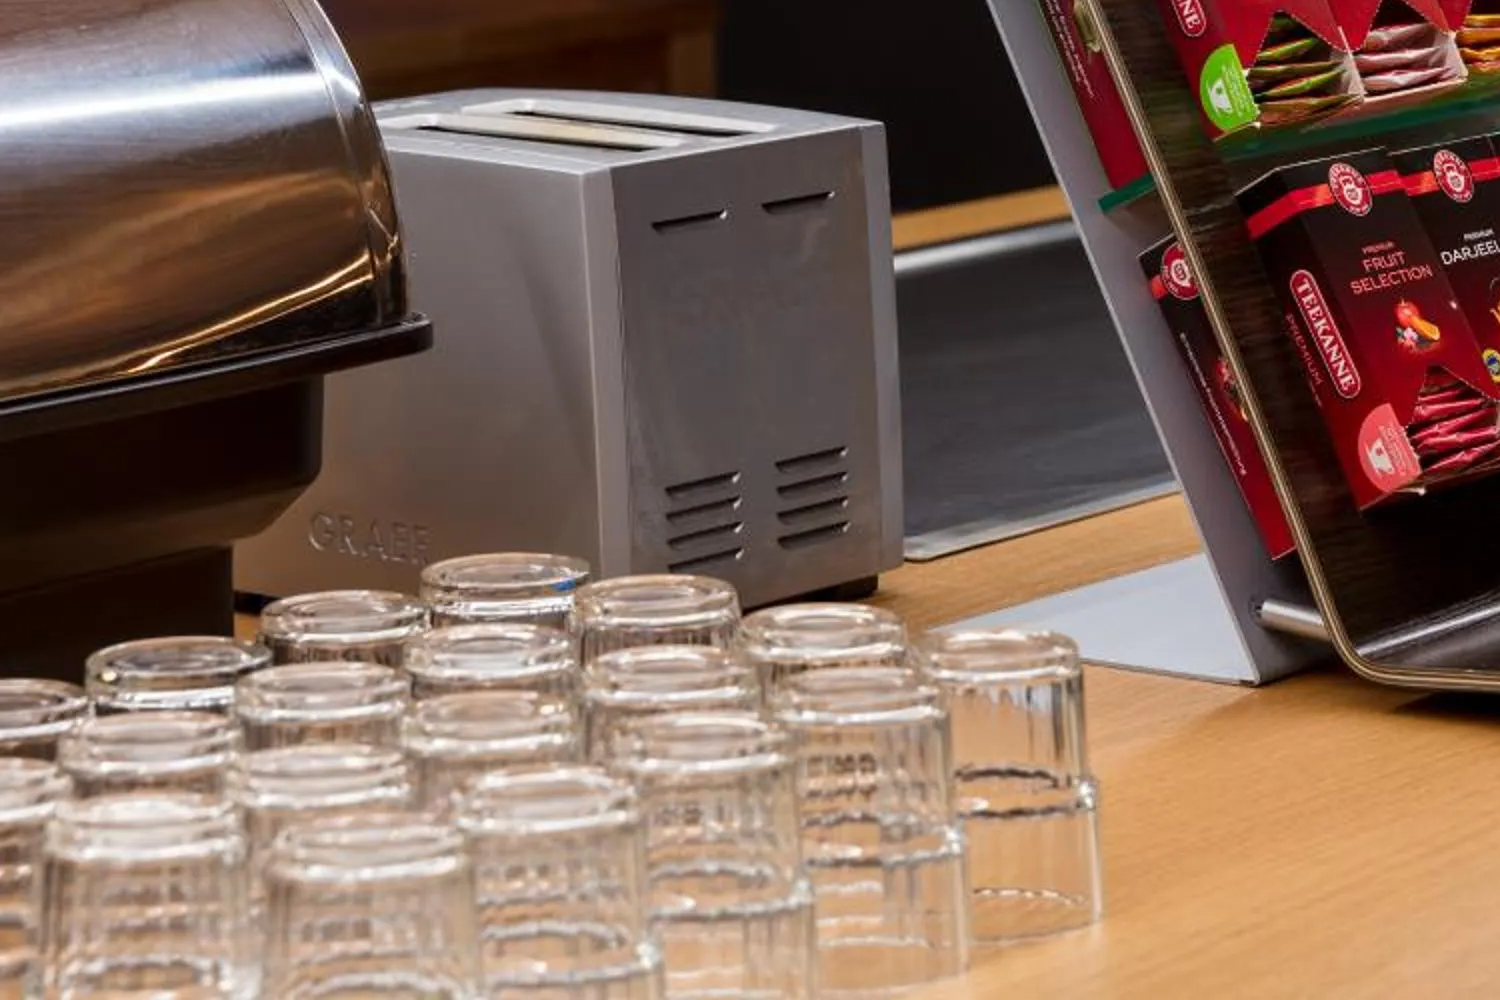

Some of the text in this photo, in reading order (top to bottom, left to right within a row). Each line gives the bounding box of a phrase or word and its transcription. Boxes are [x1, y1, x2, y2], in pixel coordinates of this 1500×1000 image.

[1351, 264, 1434, 295] SELECTION
[1362, 251, 1407, 273] FRUIT
[1296, 277, 1356, 391] TEEKANNE
[308, 511, 430, 565] GRAEF
